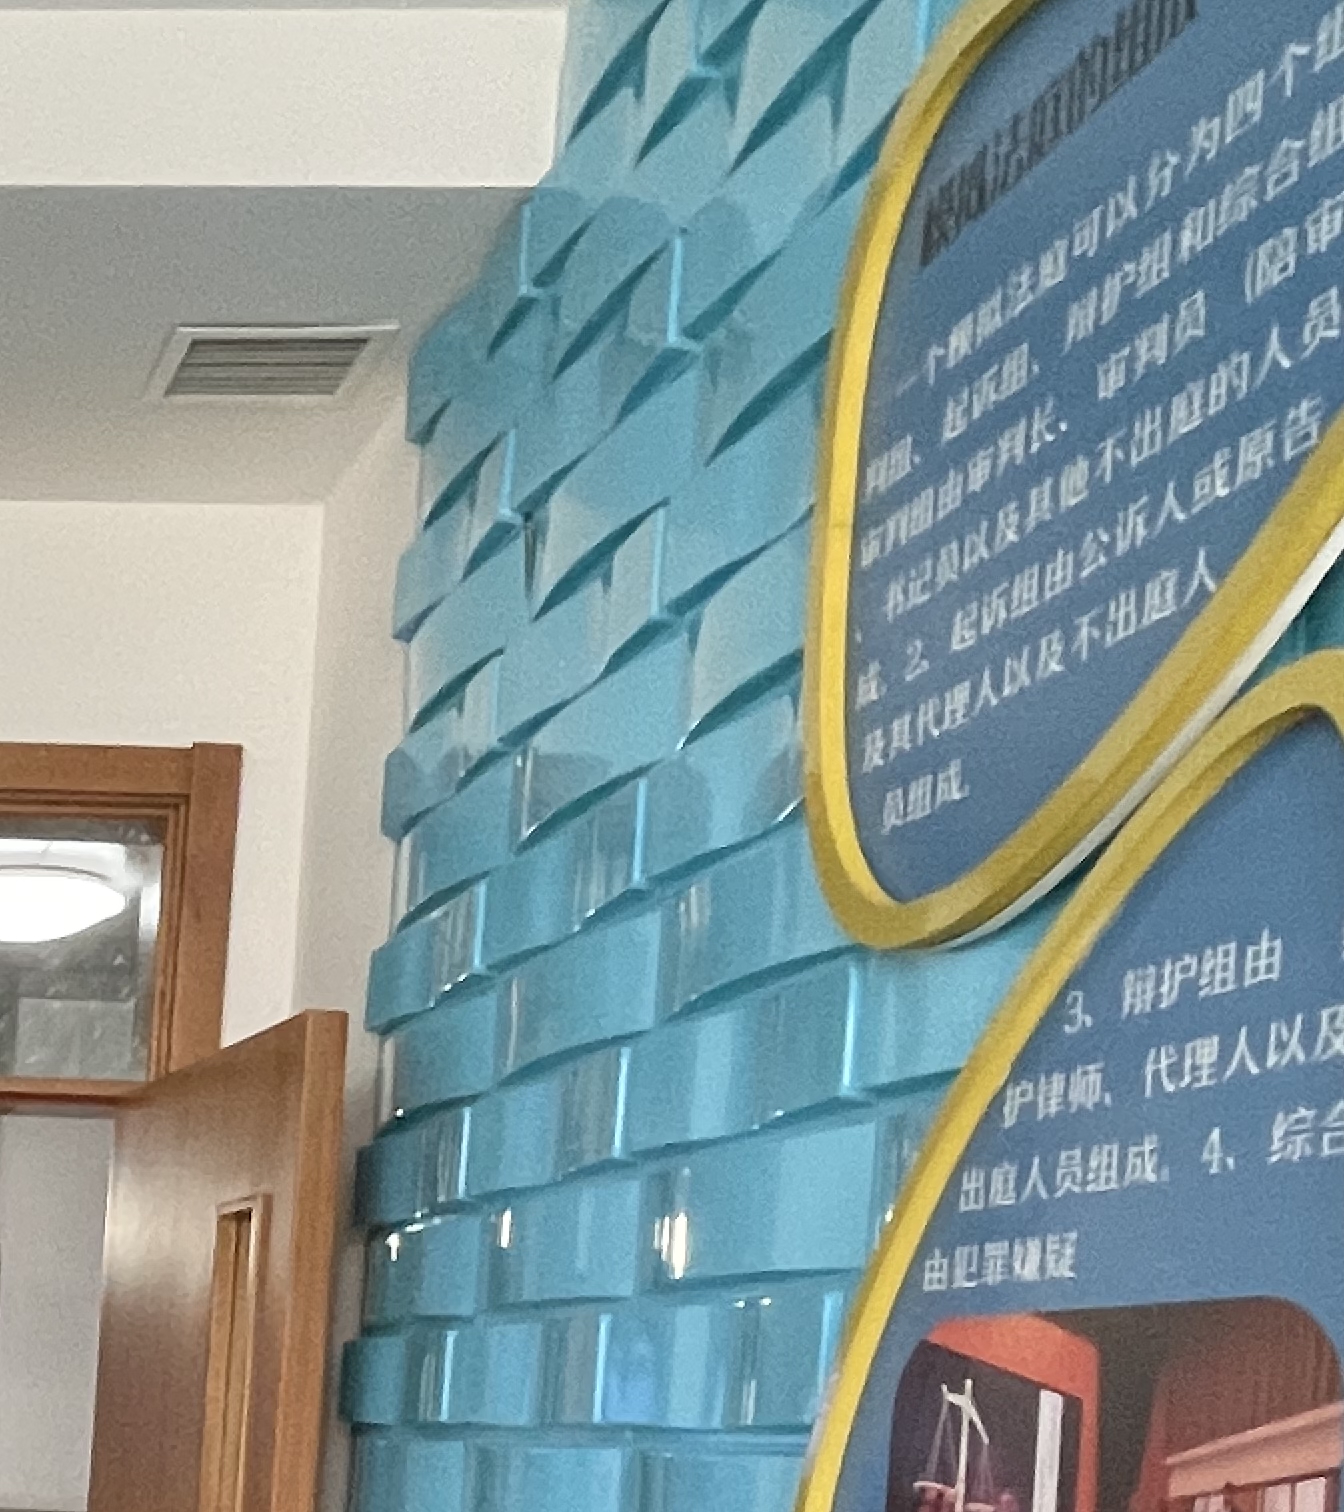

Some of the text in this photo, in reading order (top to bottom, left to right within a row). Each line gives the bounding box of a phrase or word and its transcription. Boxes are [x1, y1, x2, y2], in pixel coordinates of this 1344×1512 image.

[922, 1231, 1079, 1294] 由犯罪嫌疑
